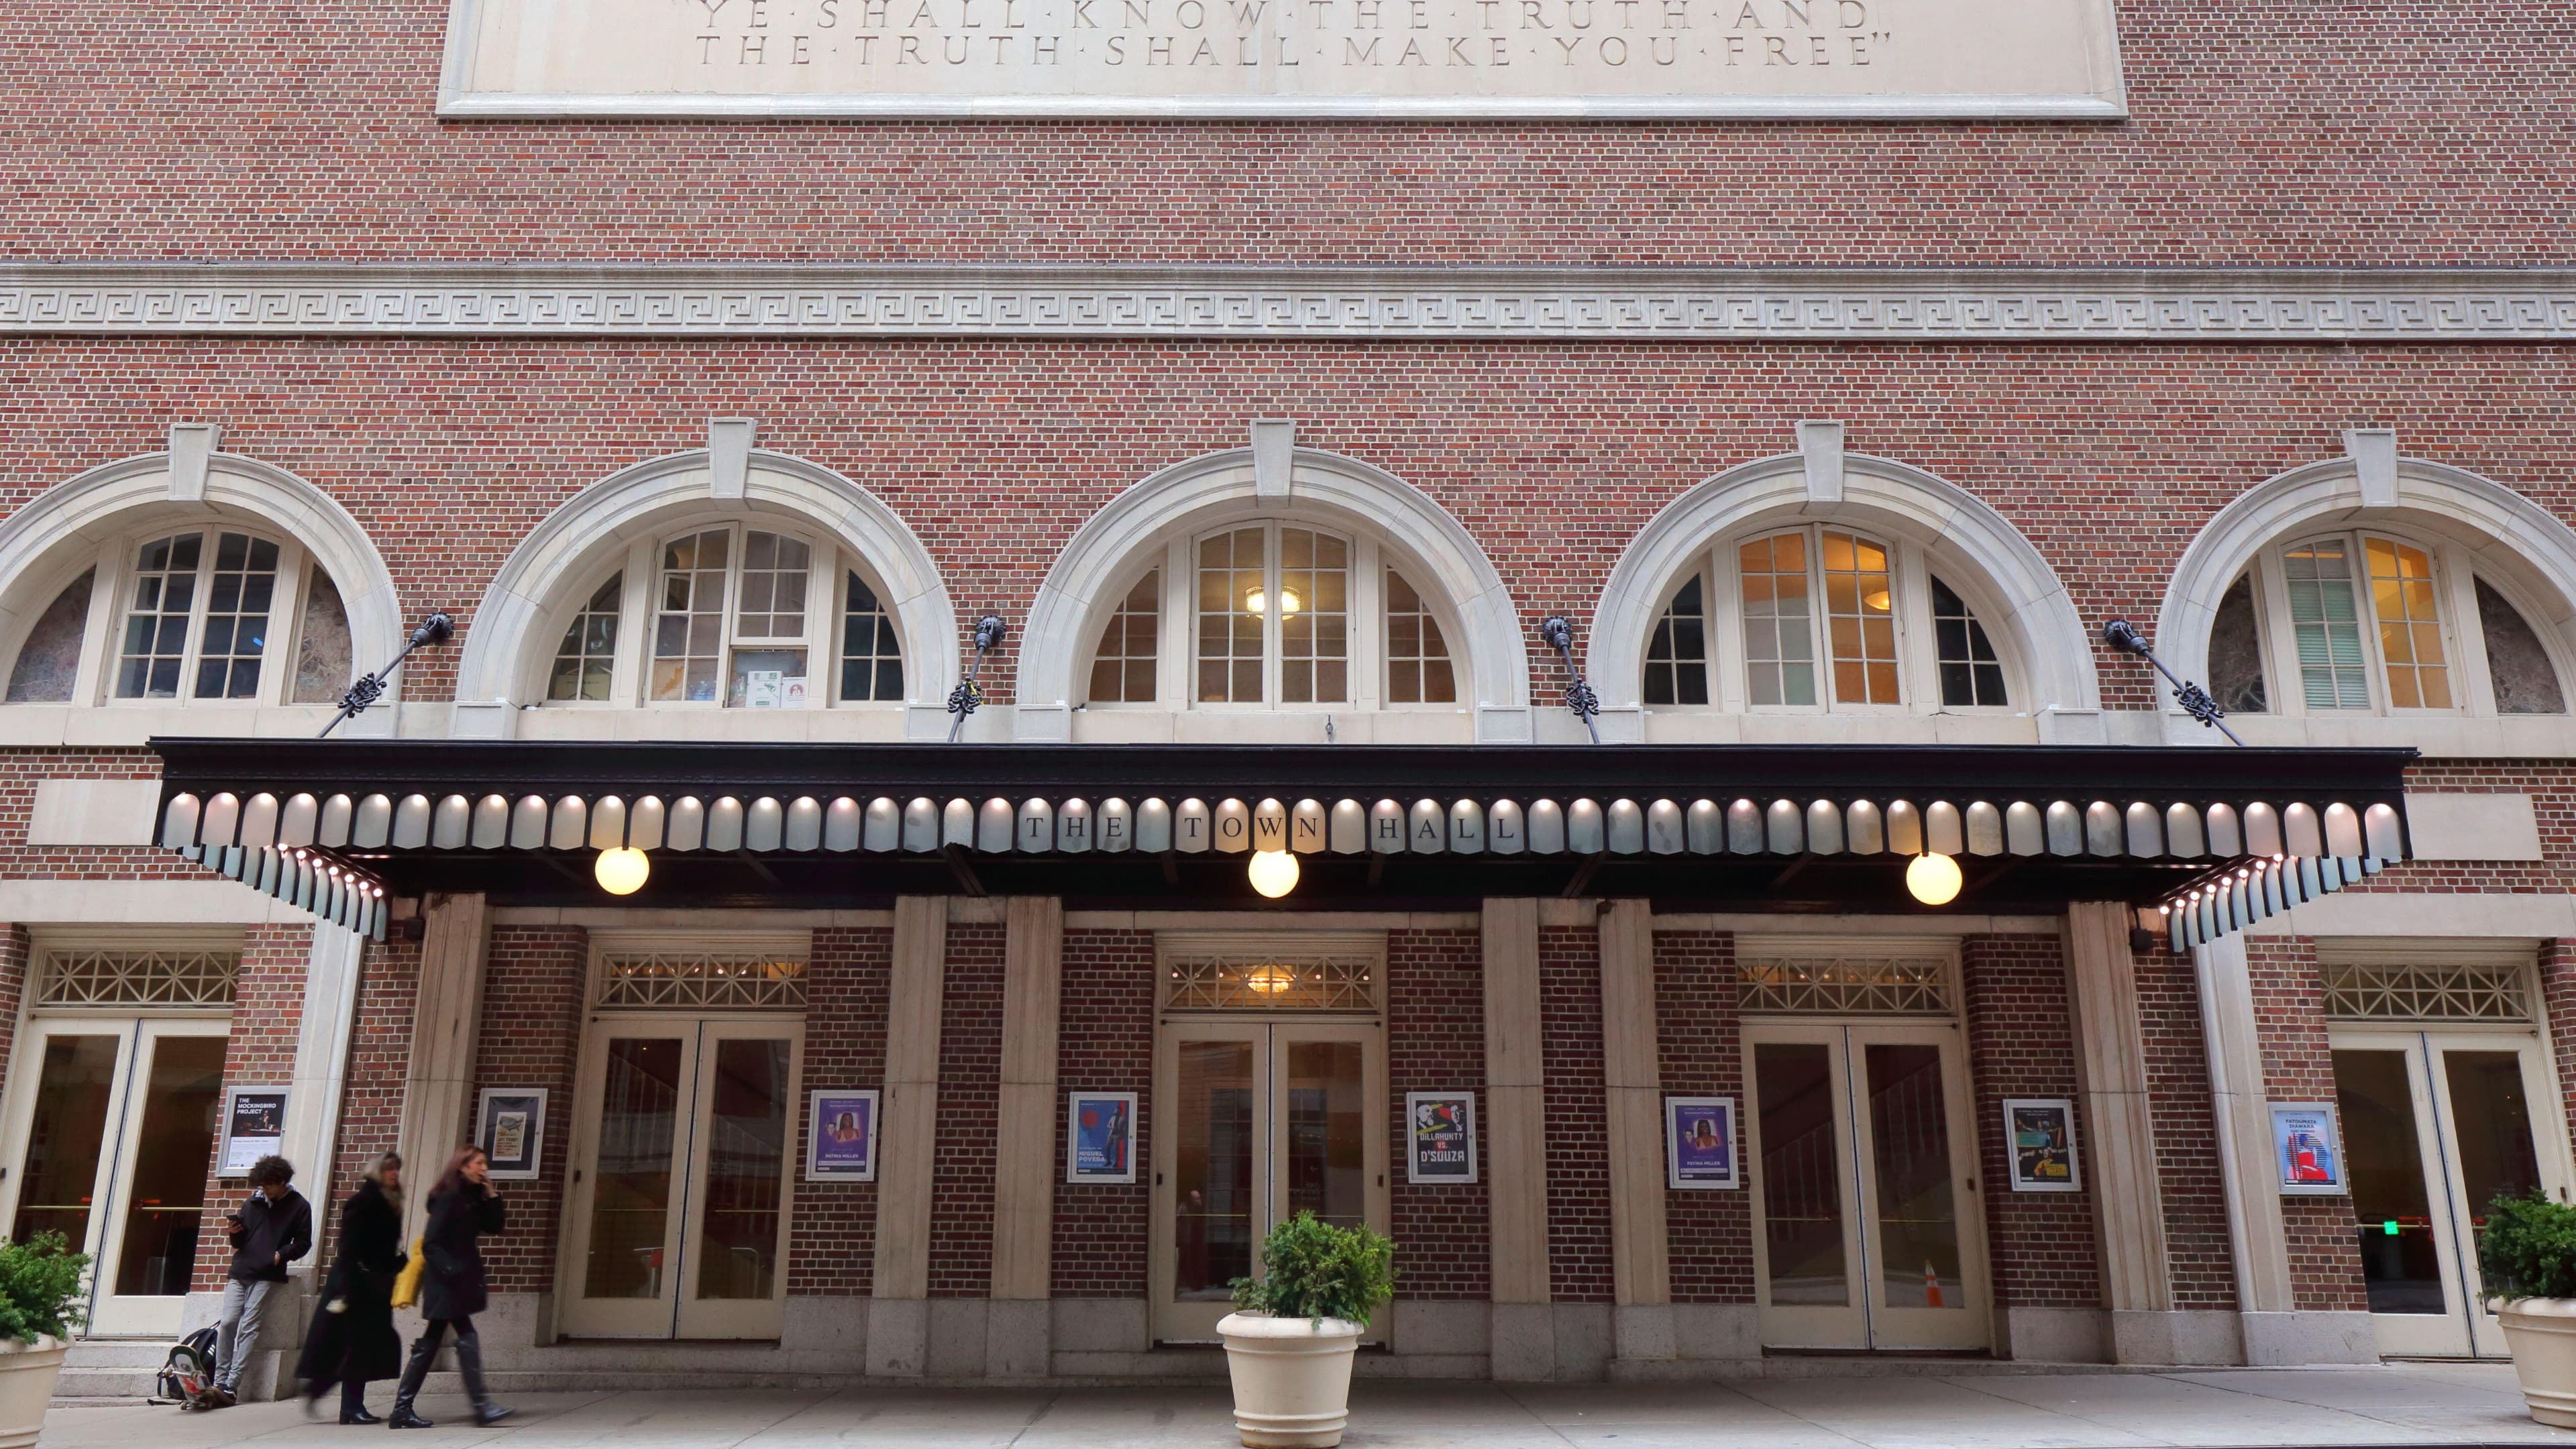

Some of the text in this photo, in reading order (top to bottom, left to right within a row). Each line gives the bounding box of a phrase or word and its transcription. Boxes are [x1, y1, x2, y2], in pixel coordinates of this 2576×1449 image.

[817, 0, 1025, 28] SHALL
[1071, 0, 1269, 29] KNOW
[1309, 1, 1429, 29] THE
[1476, 1, 1693, 29] TRUTH
[1731, 1, 1866, 29] AND
[696, 36, 810, 64] THE
[855, 36, 1063, 65] TRUTH
[1105, 36, 1299, 66] SHALL
[1341, 37, 1510, 66] MAKE
[1550, 37, 1677, 66] YOU
[1026, 816, 1515, 839] THE TOWN HALL
